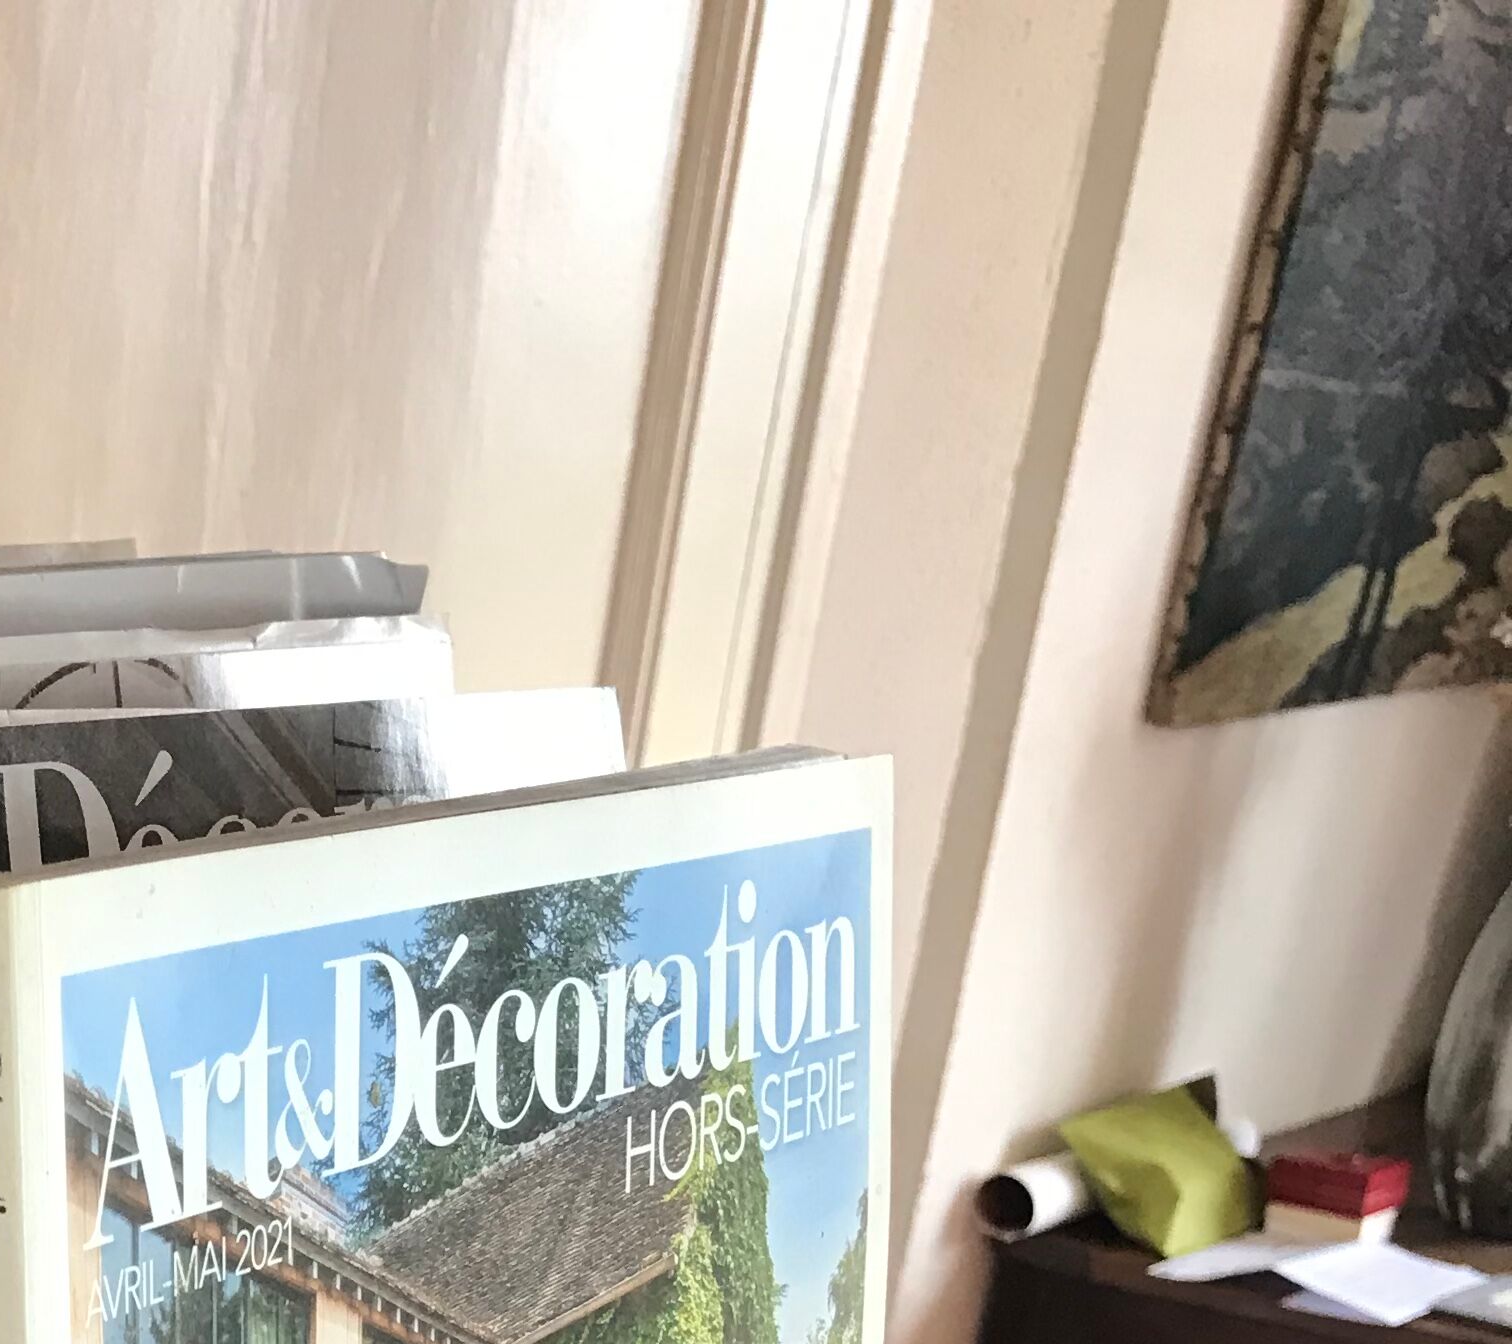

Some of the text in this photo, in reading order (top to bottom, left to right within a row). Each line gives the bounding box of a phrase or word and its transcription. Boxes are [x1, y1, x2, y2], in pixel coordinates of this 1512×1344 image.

[83, 879, 861, 1251] Art&Décoration
[624, 1050, 857, 1195] HORS-SÉRIE
[87, 1216, 294, 1329] AVRIL-MAI 2021
